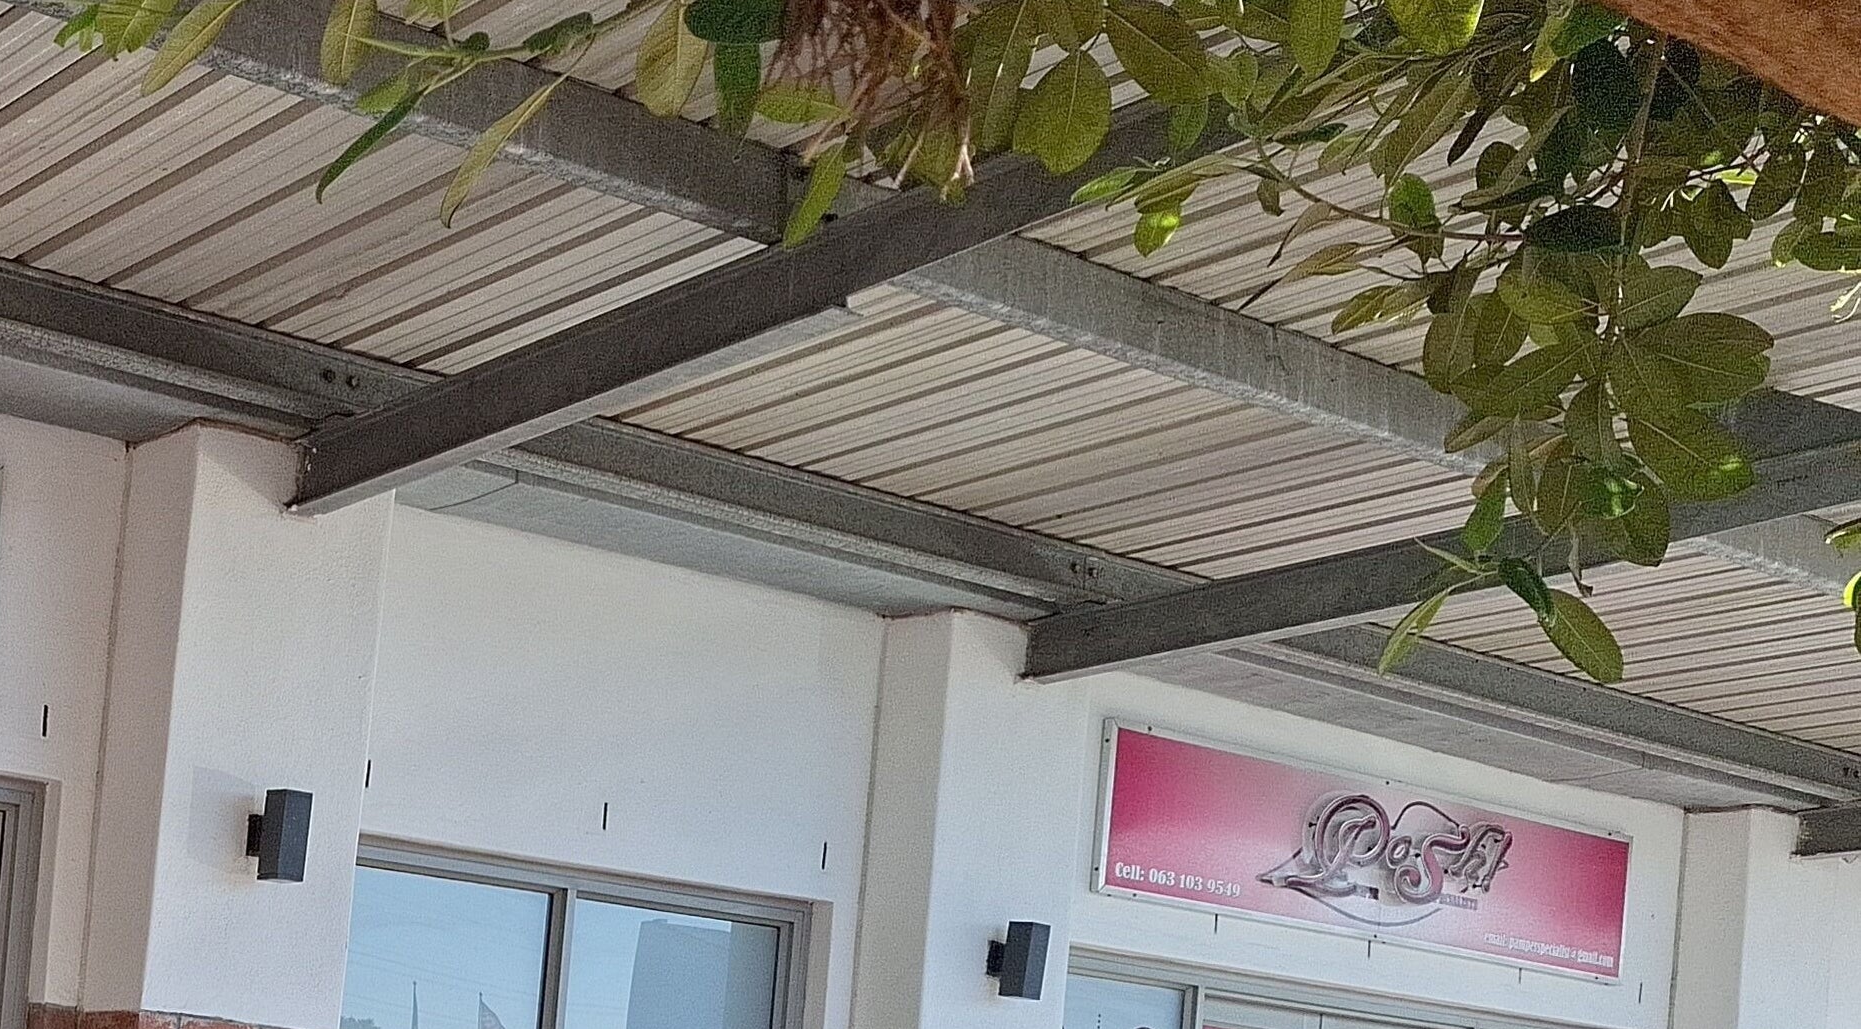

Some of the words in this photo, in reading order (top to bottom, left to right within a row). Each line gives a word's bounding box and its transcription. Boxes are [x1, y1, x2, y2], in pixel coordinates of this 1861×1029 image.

[1114, 861, 1145, 881] Cell:
[1149, 868, 1176, 886] 063
[1179, 874, 1203, 891] 103
[1207, 879, 1241, 898] 9549
